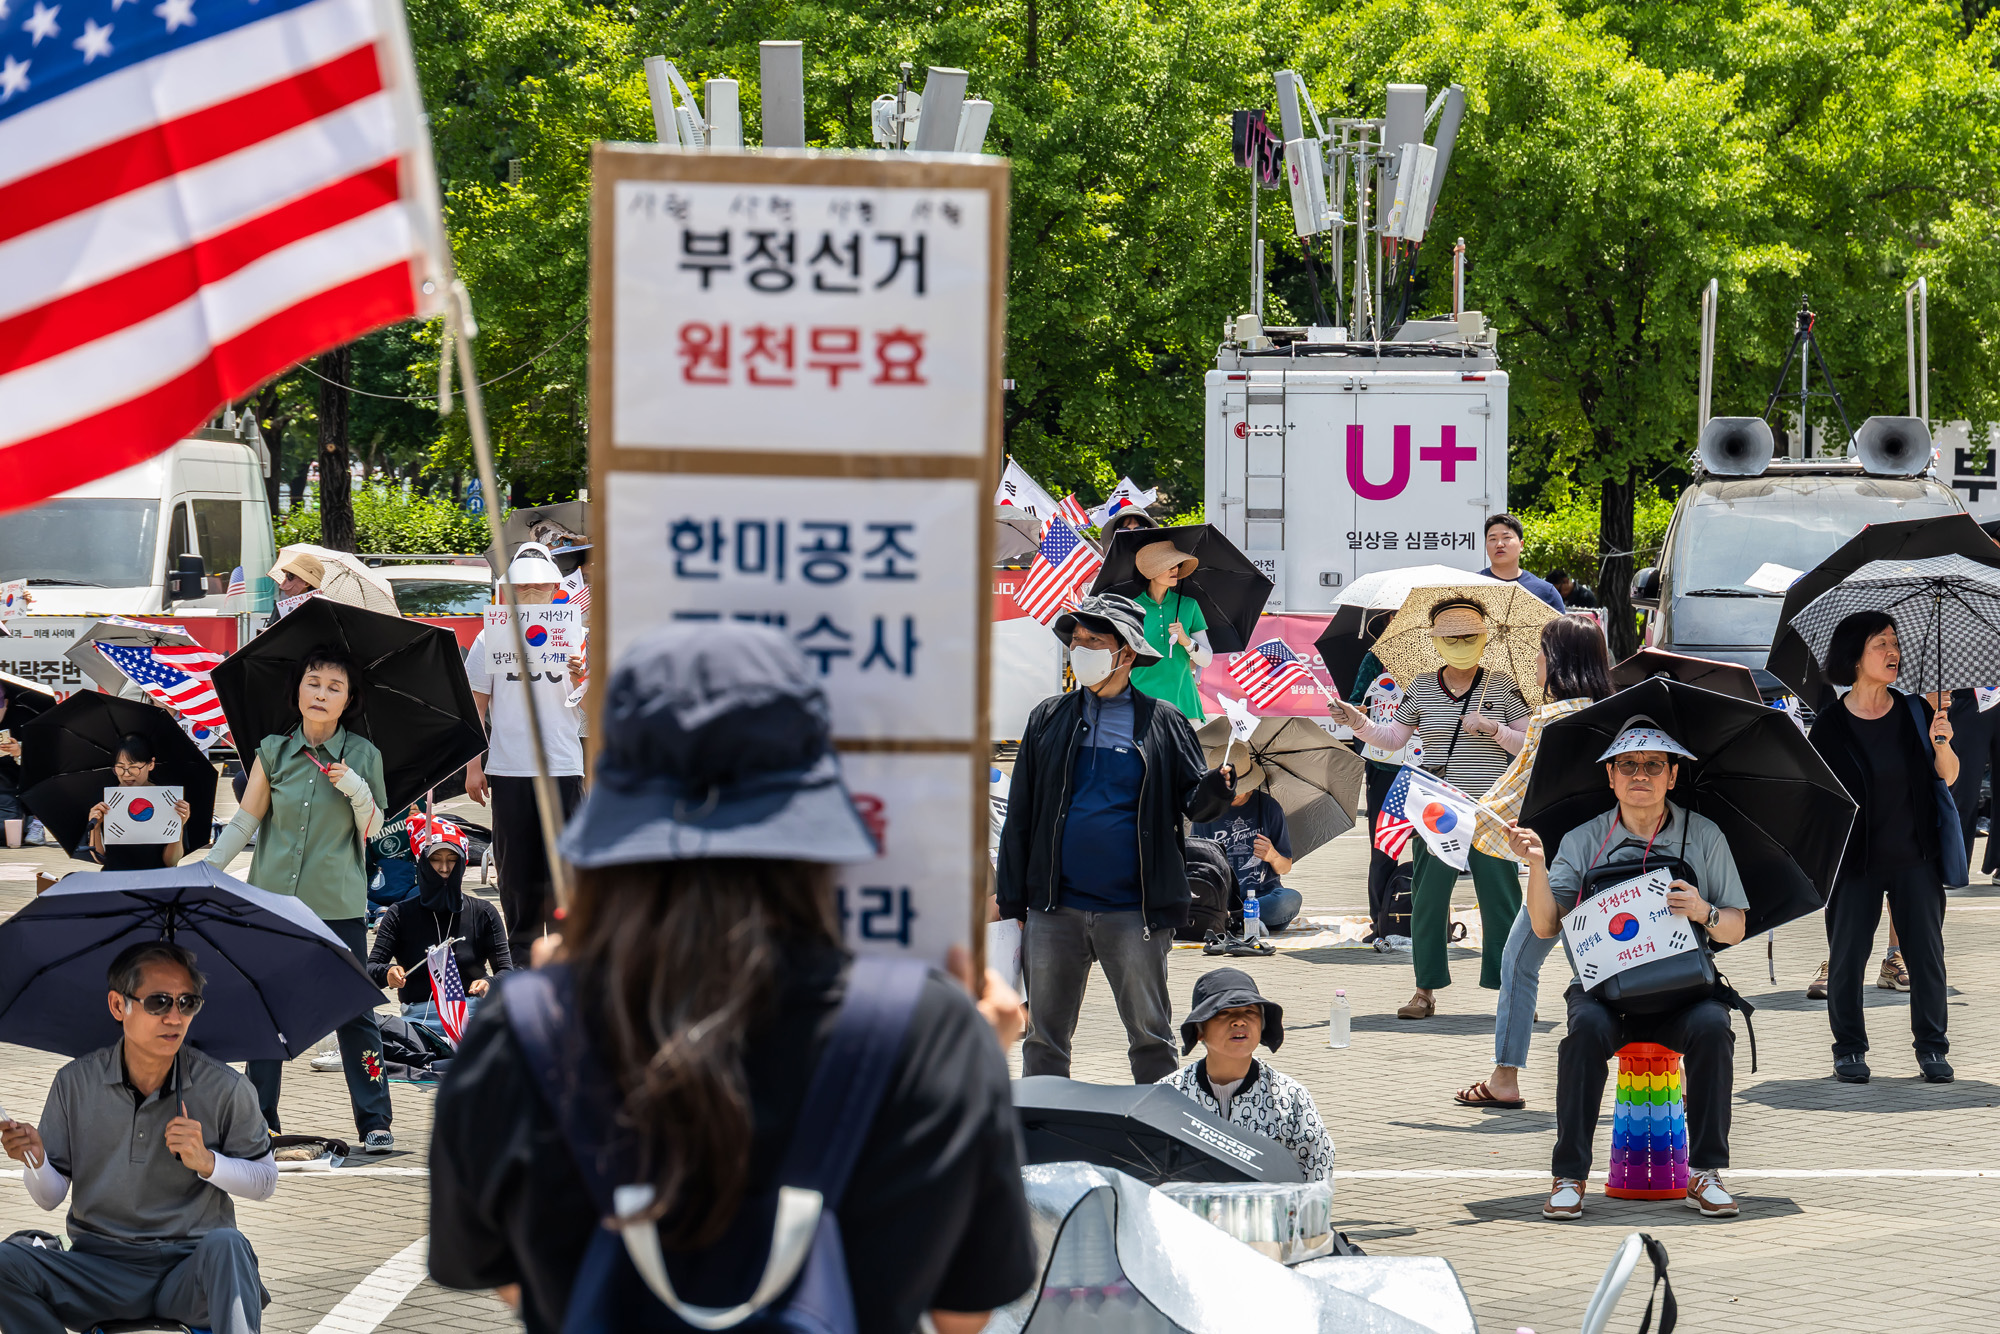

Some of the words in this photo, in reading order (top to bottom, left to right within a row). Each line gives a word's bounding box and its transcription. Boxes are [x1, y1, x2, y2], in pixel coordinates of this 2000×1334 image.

[678, 228, 928, 295] 부정선거
[676, 321, 928, 389] 원천무효
[1346, 424, 1478, 501] U+
[667, 515, 918, 585] 한미공조
[1345, 531, 1400, 550] 일상을
[1404, 531, 1477, 550] 심플하게
[487, 610, 530, 626] 부정거
[538, 610, 574, 623] 재선거
[52, 628, 75, 639] 사이에
[550, 640, 573, 648] STEAL
[1290, 685, 1315, 695] 일상을
[1597, 886, 1642, 915] 부정선거
[1576, 931, 1603, 957] 당일투표
[1615, 941, 1657, 962] 재선거
